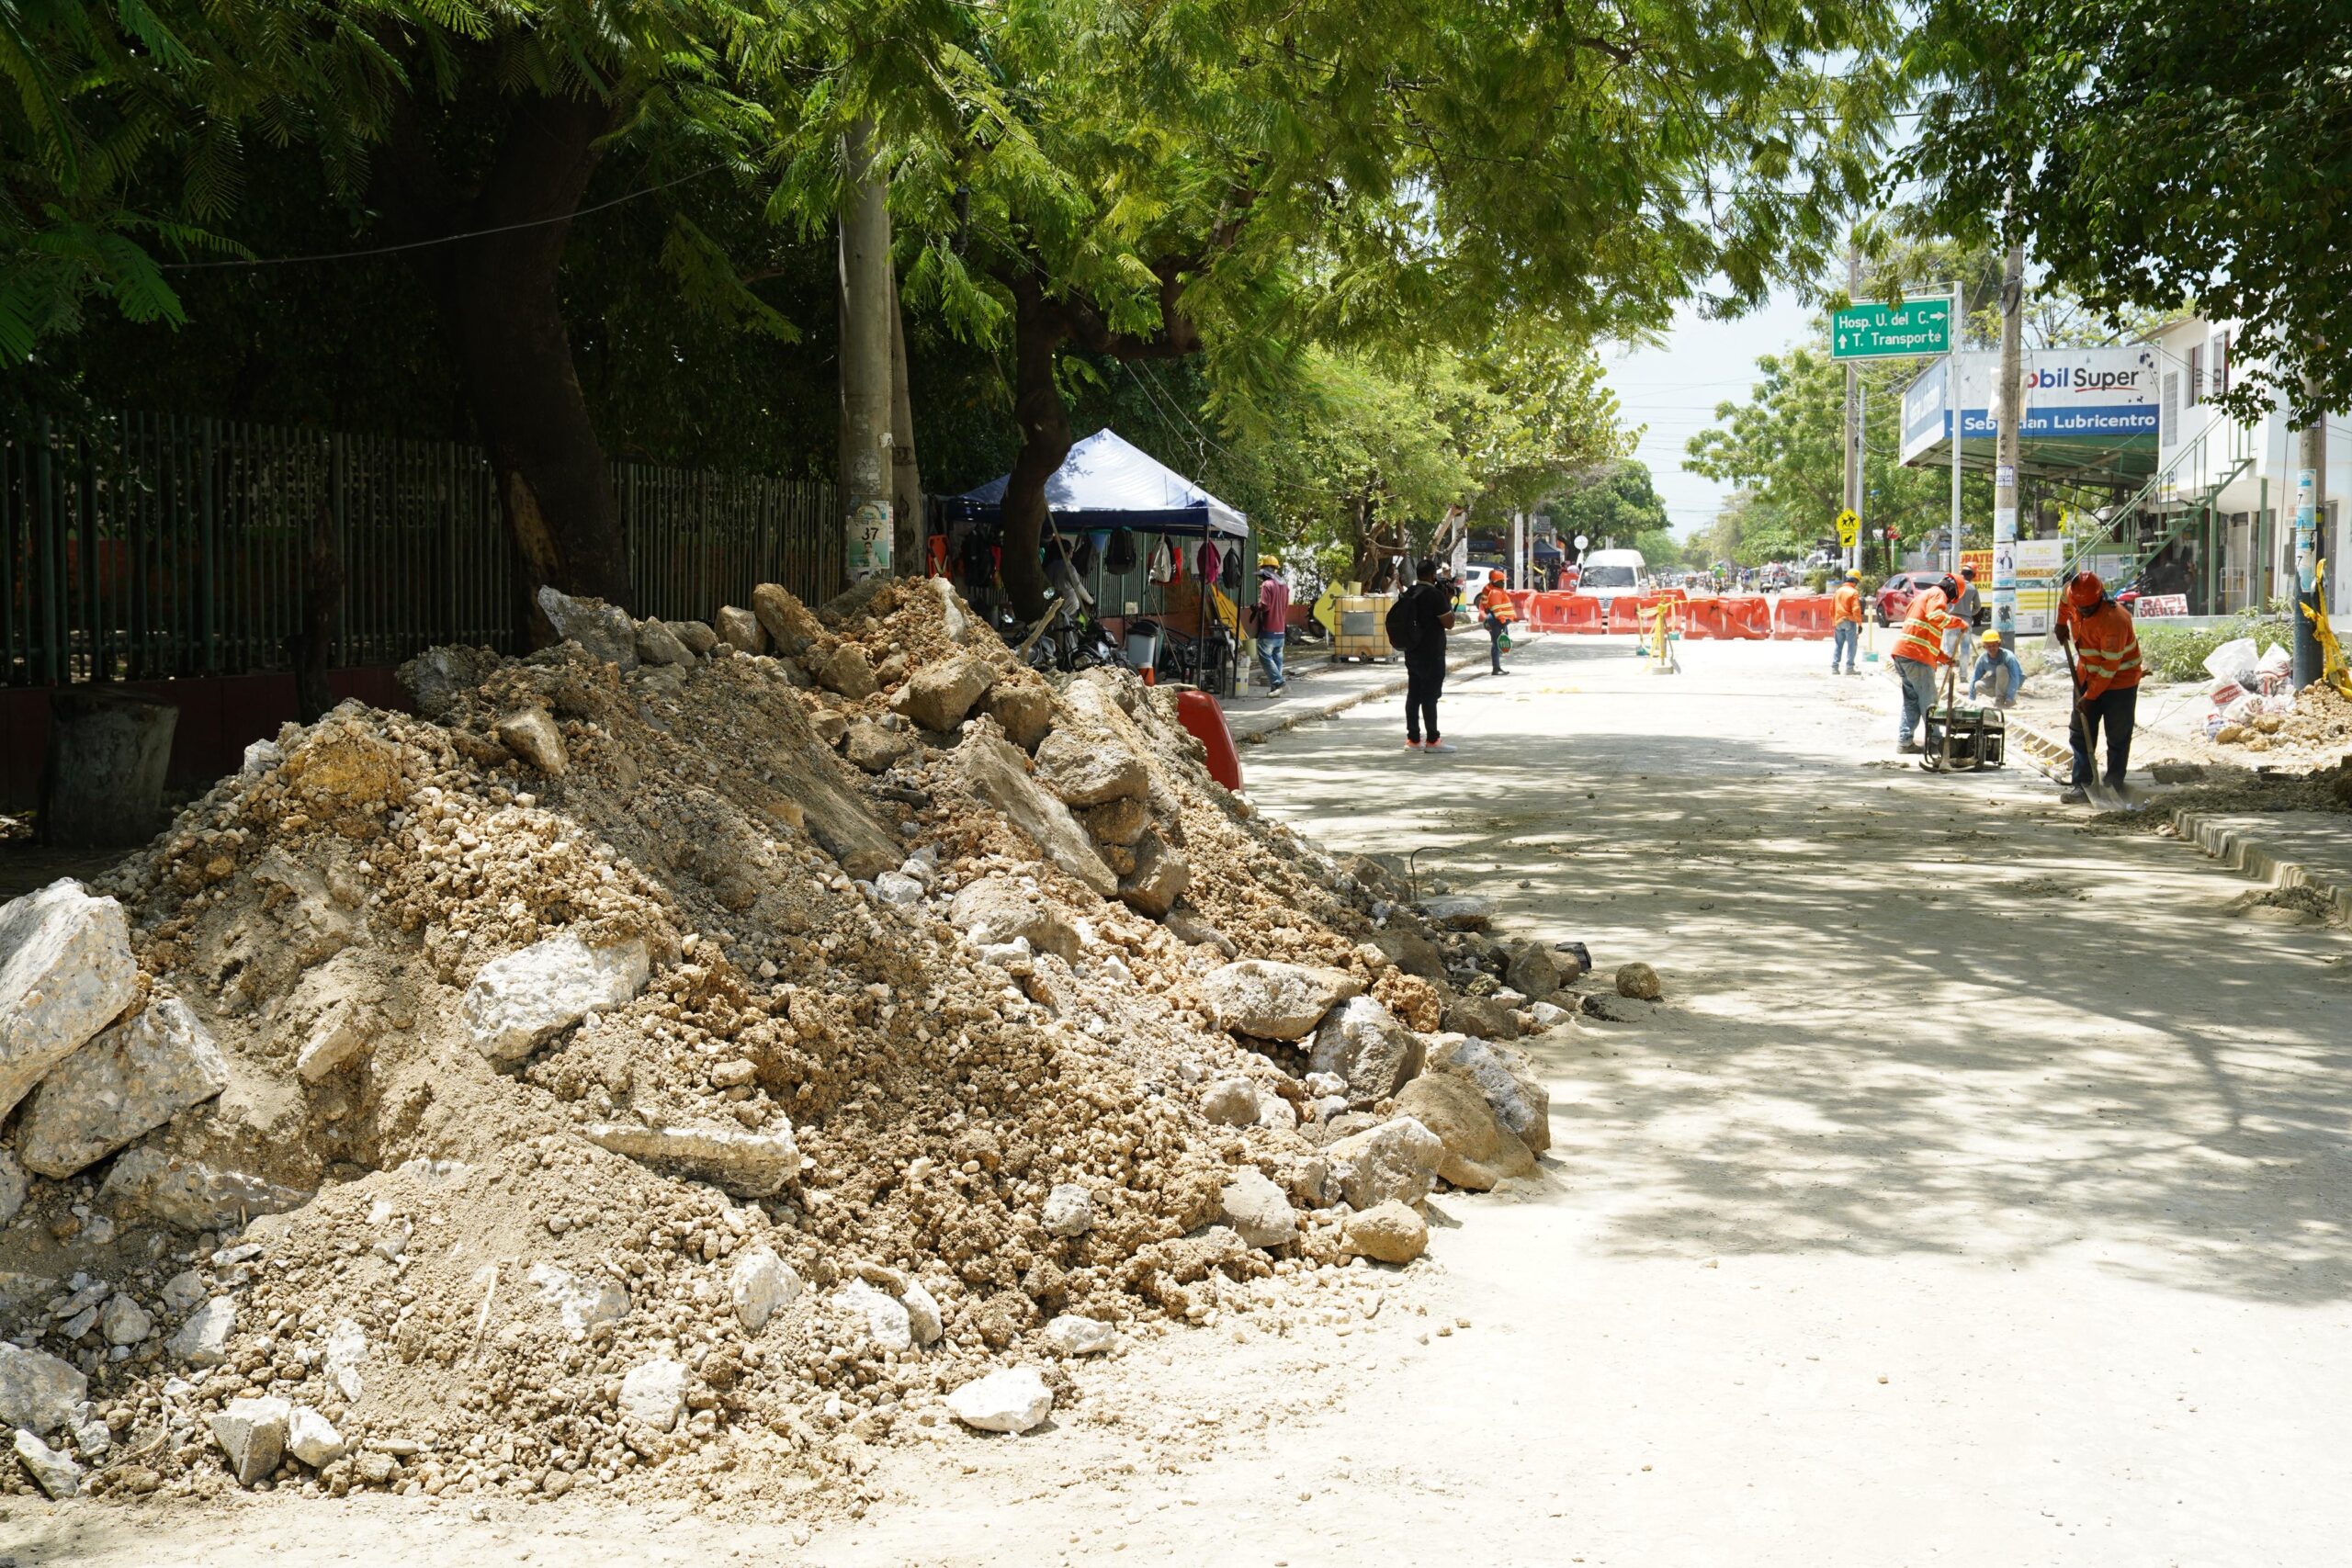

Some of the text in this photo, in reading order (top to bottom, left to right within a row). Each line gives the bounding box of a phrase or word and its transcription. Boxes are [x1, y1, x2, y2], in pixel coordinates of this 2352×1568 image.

[1838, 310, 1929, 332] Hosp. U. del C.
[1852, 329, 1941, 349] T. Transporte
[2027, 367, 2139, 391] obil Super
[1964, 413, 2156, 431] Sebian Lubricentro
[861, 527, 879, 540] 37
